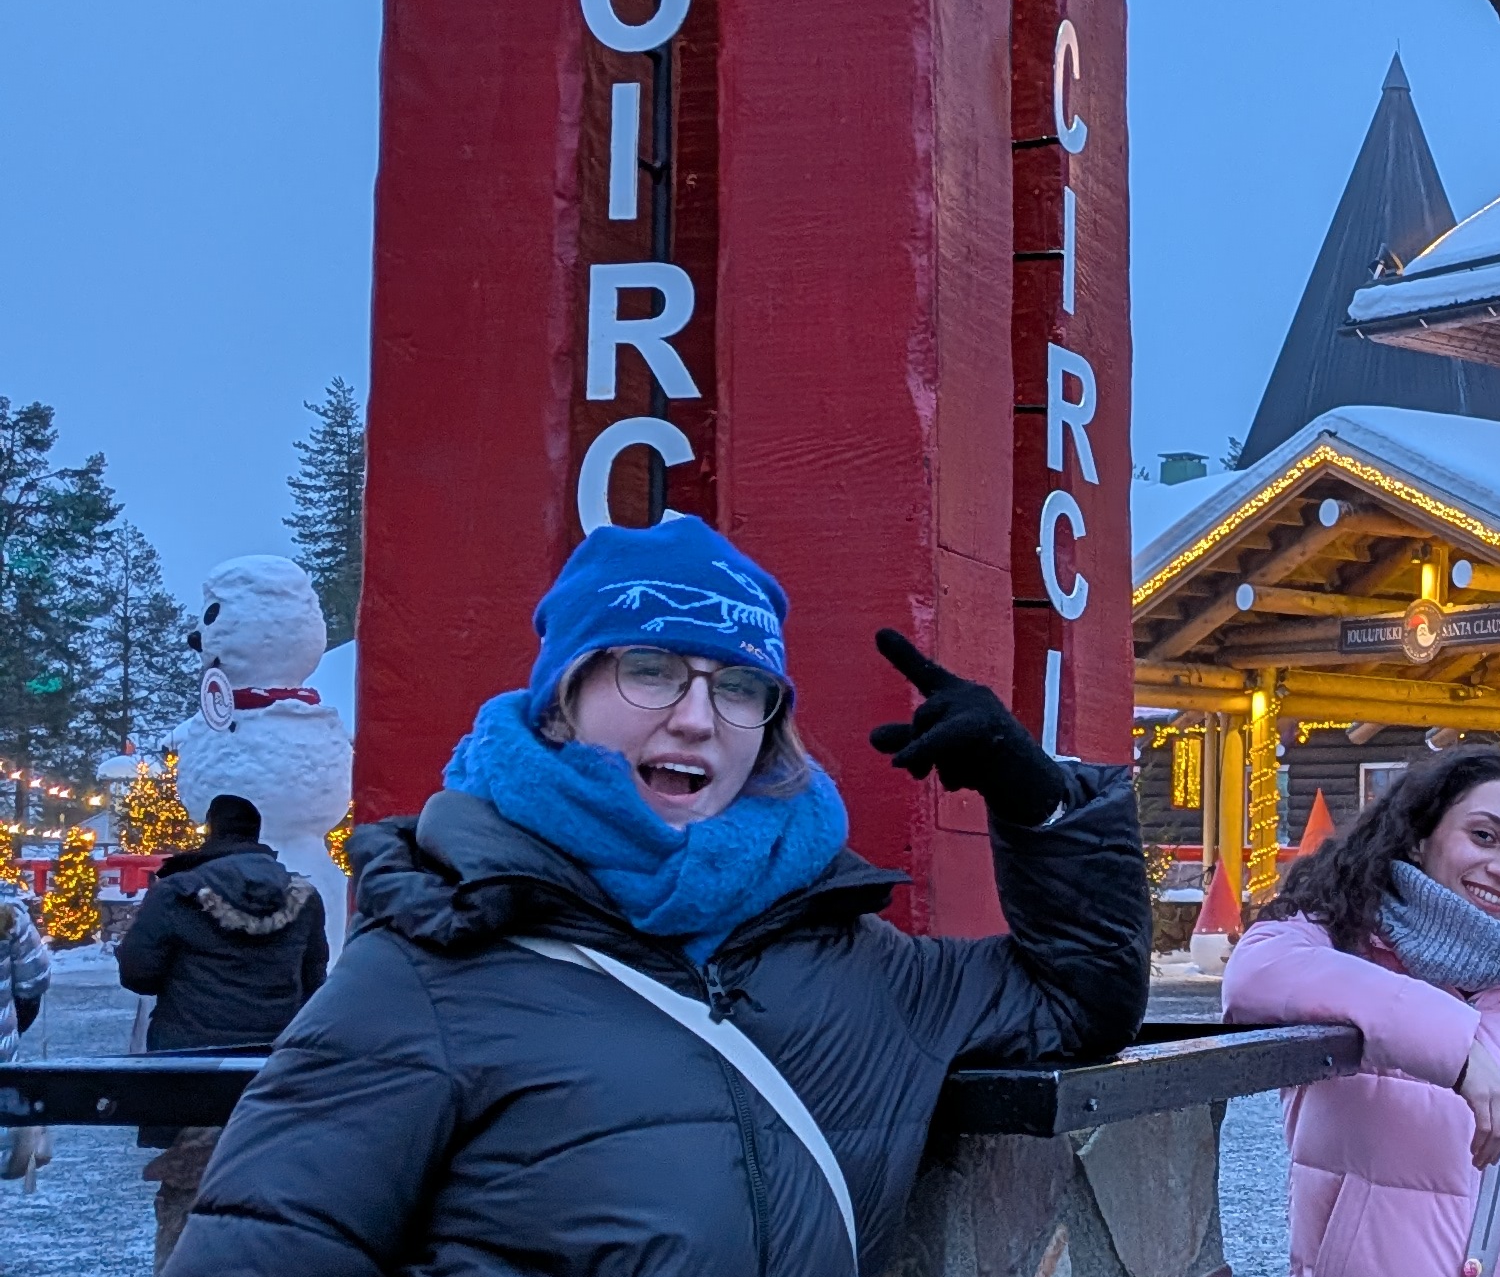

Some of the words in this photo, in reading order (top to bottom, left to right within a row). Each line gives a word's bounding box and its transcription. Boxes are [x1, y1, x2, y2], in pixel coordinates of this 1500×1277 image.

[1039, 20, 1099, 762] CIRCL
[1346, 626, 1403, 644] JOULUPUKKI
[1441, 621, 1472, 636] SANTA
